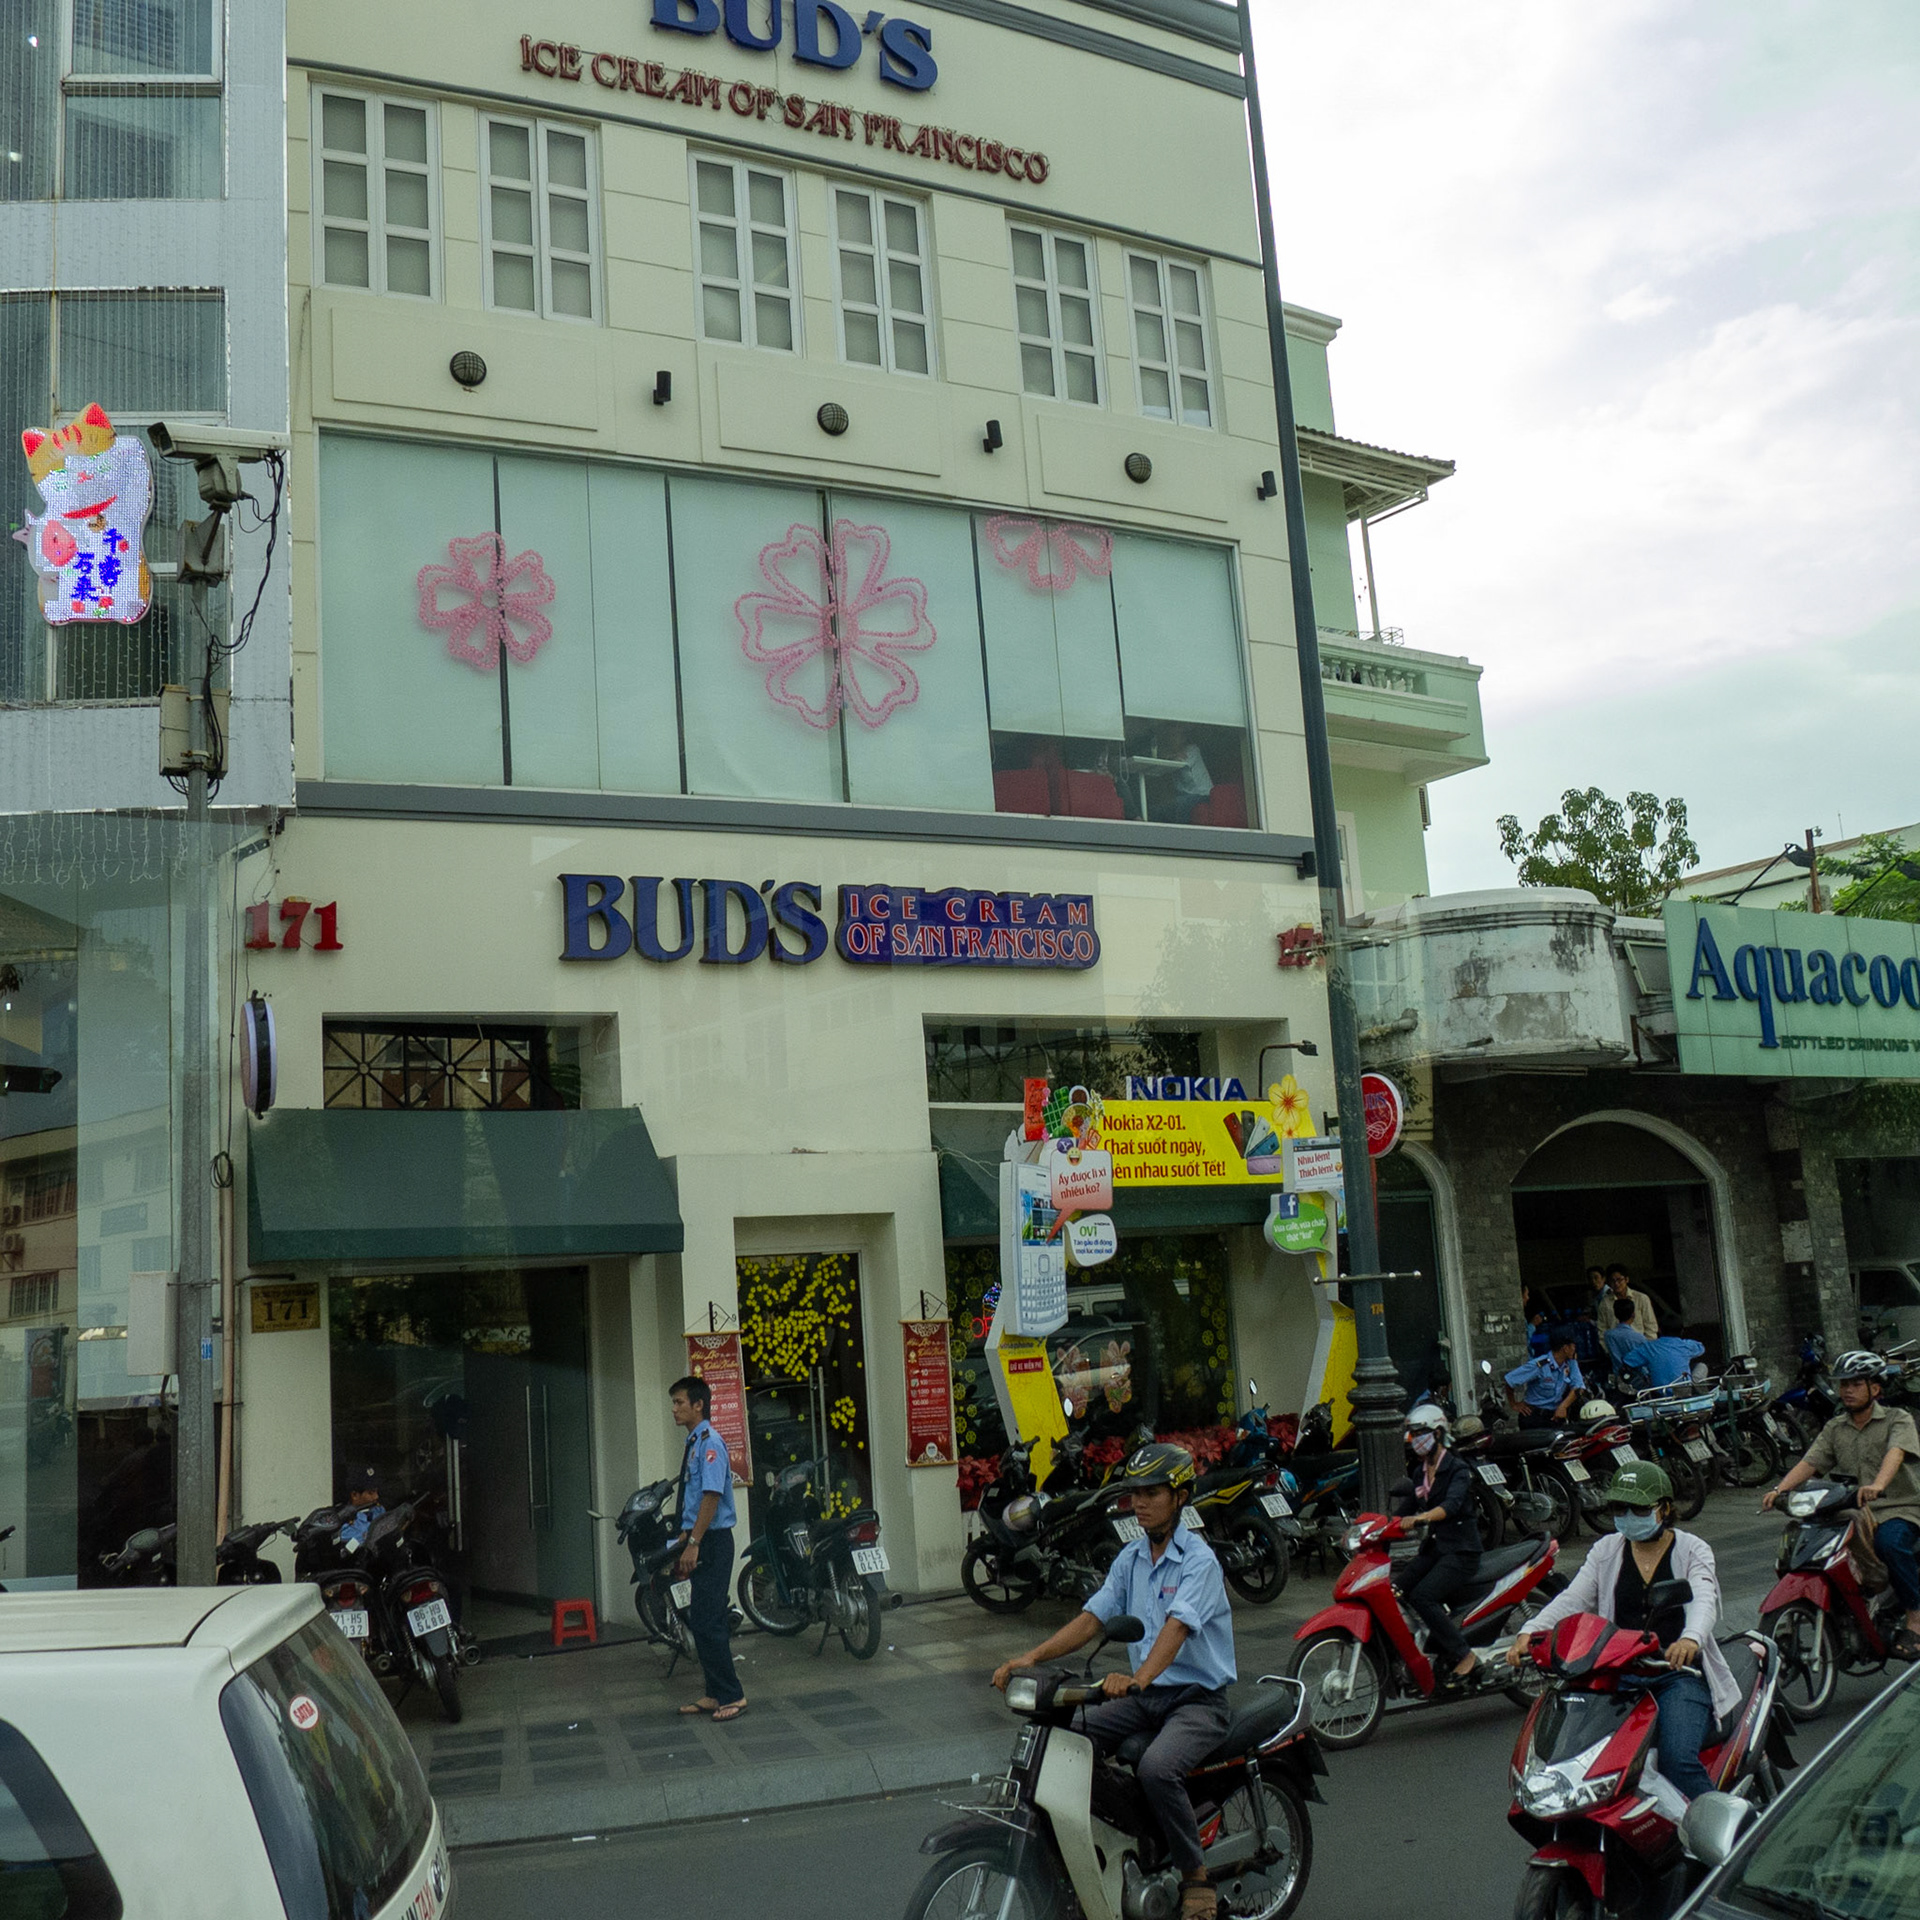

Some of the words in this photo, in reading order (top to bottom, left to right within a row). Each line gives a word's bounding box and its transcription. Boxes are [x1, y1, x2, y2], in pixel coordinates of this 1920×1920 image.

[520, 33, 583, 81] ICE
[591, 52, 720, 110] CREAM
[728, 80, 775, 121] OF
[783, 92, 855, 140] SAN
[864, 109, 1050, 184] FRANCISCO
[557, 873, 828, 964] BUD'S
[850, 893, 916, 920] ICE
[945, 896, 1088, 926] CREAM
[245, 898, 344, 951] 171
[847, 922, 885, 956] OF
[892, 924, 946, 958] SAN
[951, 925, 1094, 961] FRANCISCO
[1781, 1035, 1846, 1051] BOTTLED
[1849, 1036, 1910, 1053] DRINKING
[1126, 1076, 1249, 1101] NOKIA
[1103, 1115, 1143, 1131] Nokia
[1146, 1115, 1186, 1130] X2-01.
[1104, 1138, 1135, 1155] Chat
[1139, 1137, 1167, 1155] suốt
[1170, 1138, 1206, 1158] ngày,
[1135, 1162, 1169, 1179] nhau
[1171, 1159, 1200, 1177] suốt
[1202, 1158, 1226, 1177] Tết!
[1086, 1182, 1101, 1194] ko?
[263, 1298, 308, 1322] 171
[858, 1550, 882, 1562] 61-L5
[860, 1561, 885, 1572] 0412
[413, 1603, 442, 1622] 86-H9
[417, 1616, 445, 1633] 5488
